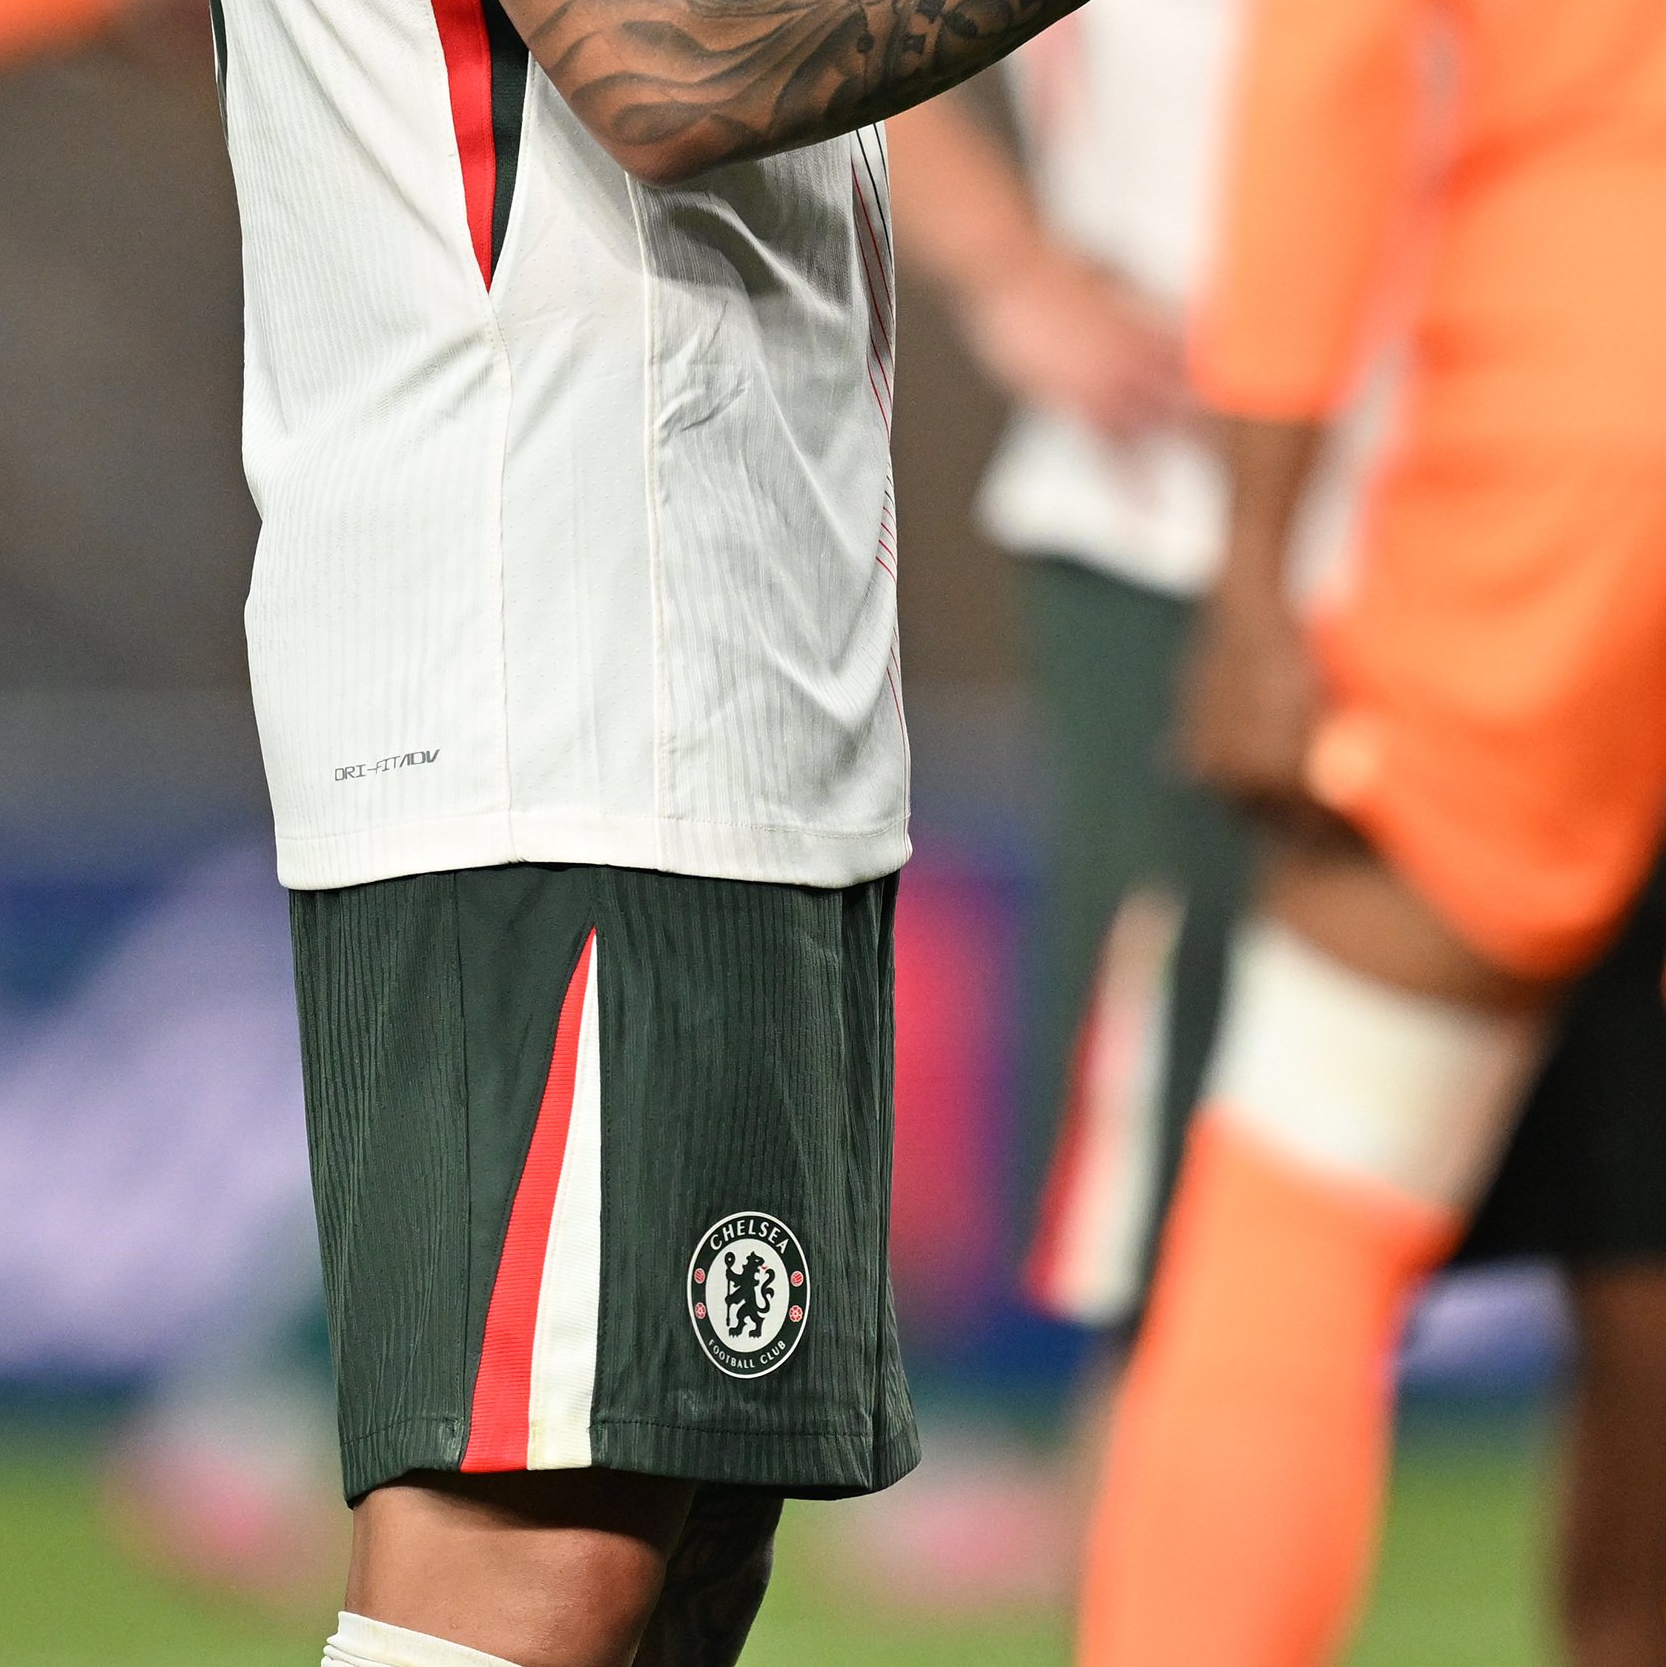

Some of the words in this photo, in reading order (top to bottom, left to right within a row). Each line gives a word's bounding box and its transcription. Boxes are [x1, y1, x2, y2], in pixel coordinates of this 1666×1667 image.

[709, 1218, 790, 1254] CHELSEA
[708, 1337, 756, 1369] FOOTBALL
[759, 1339, 787, 1364] CLUB
